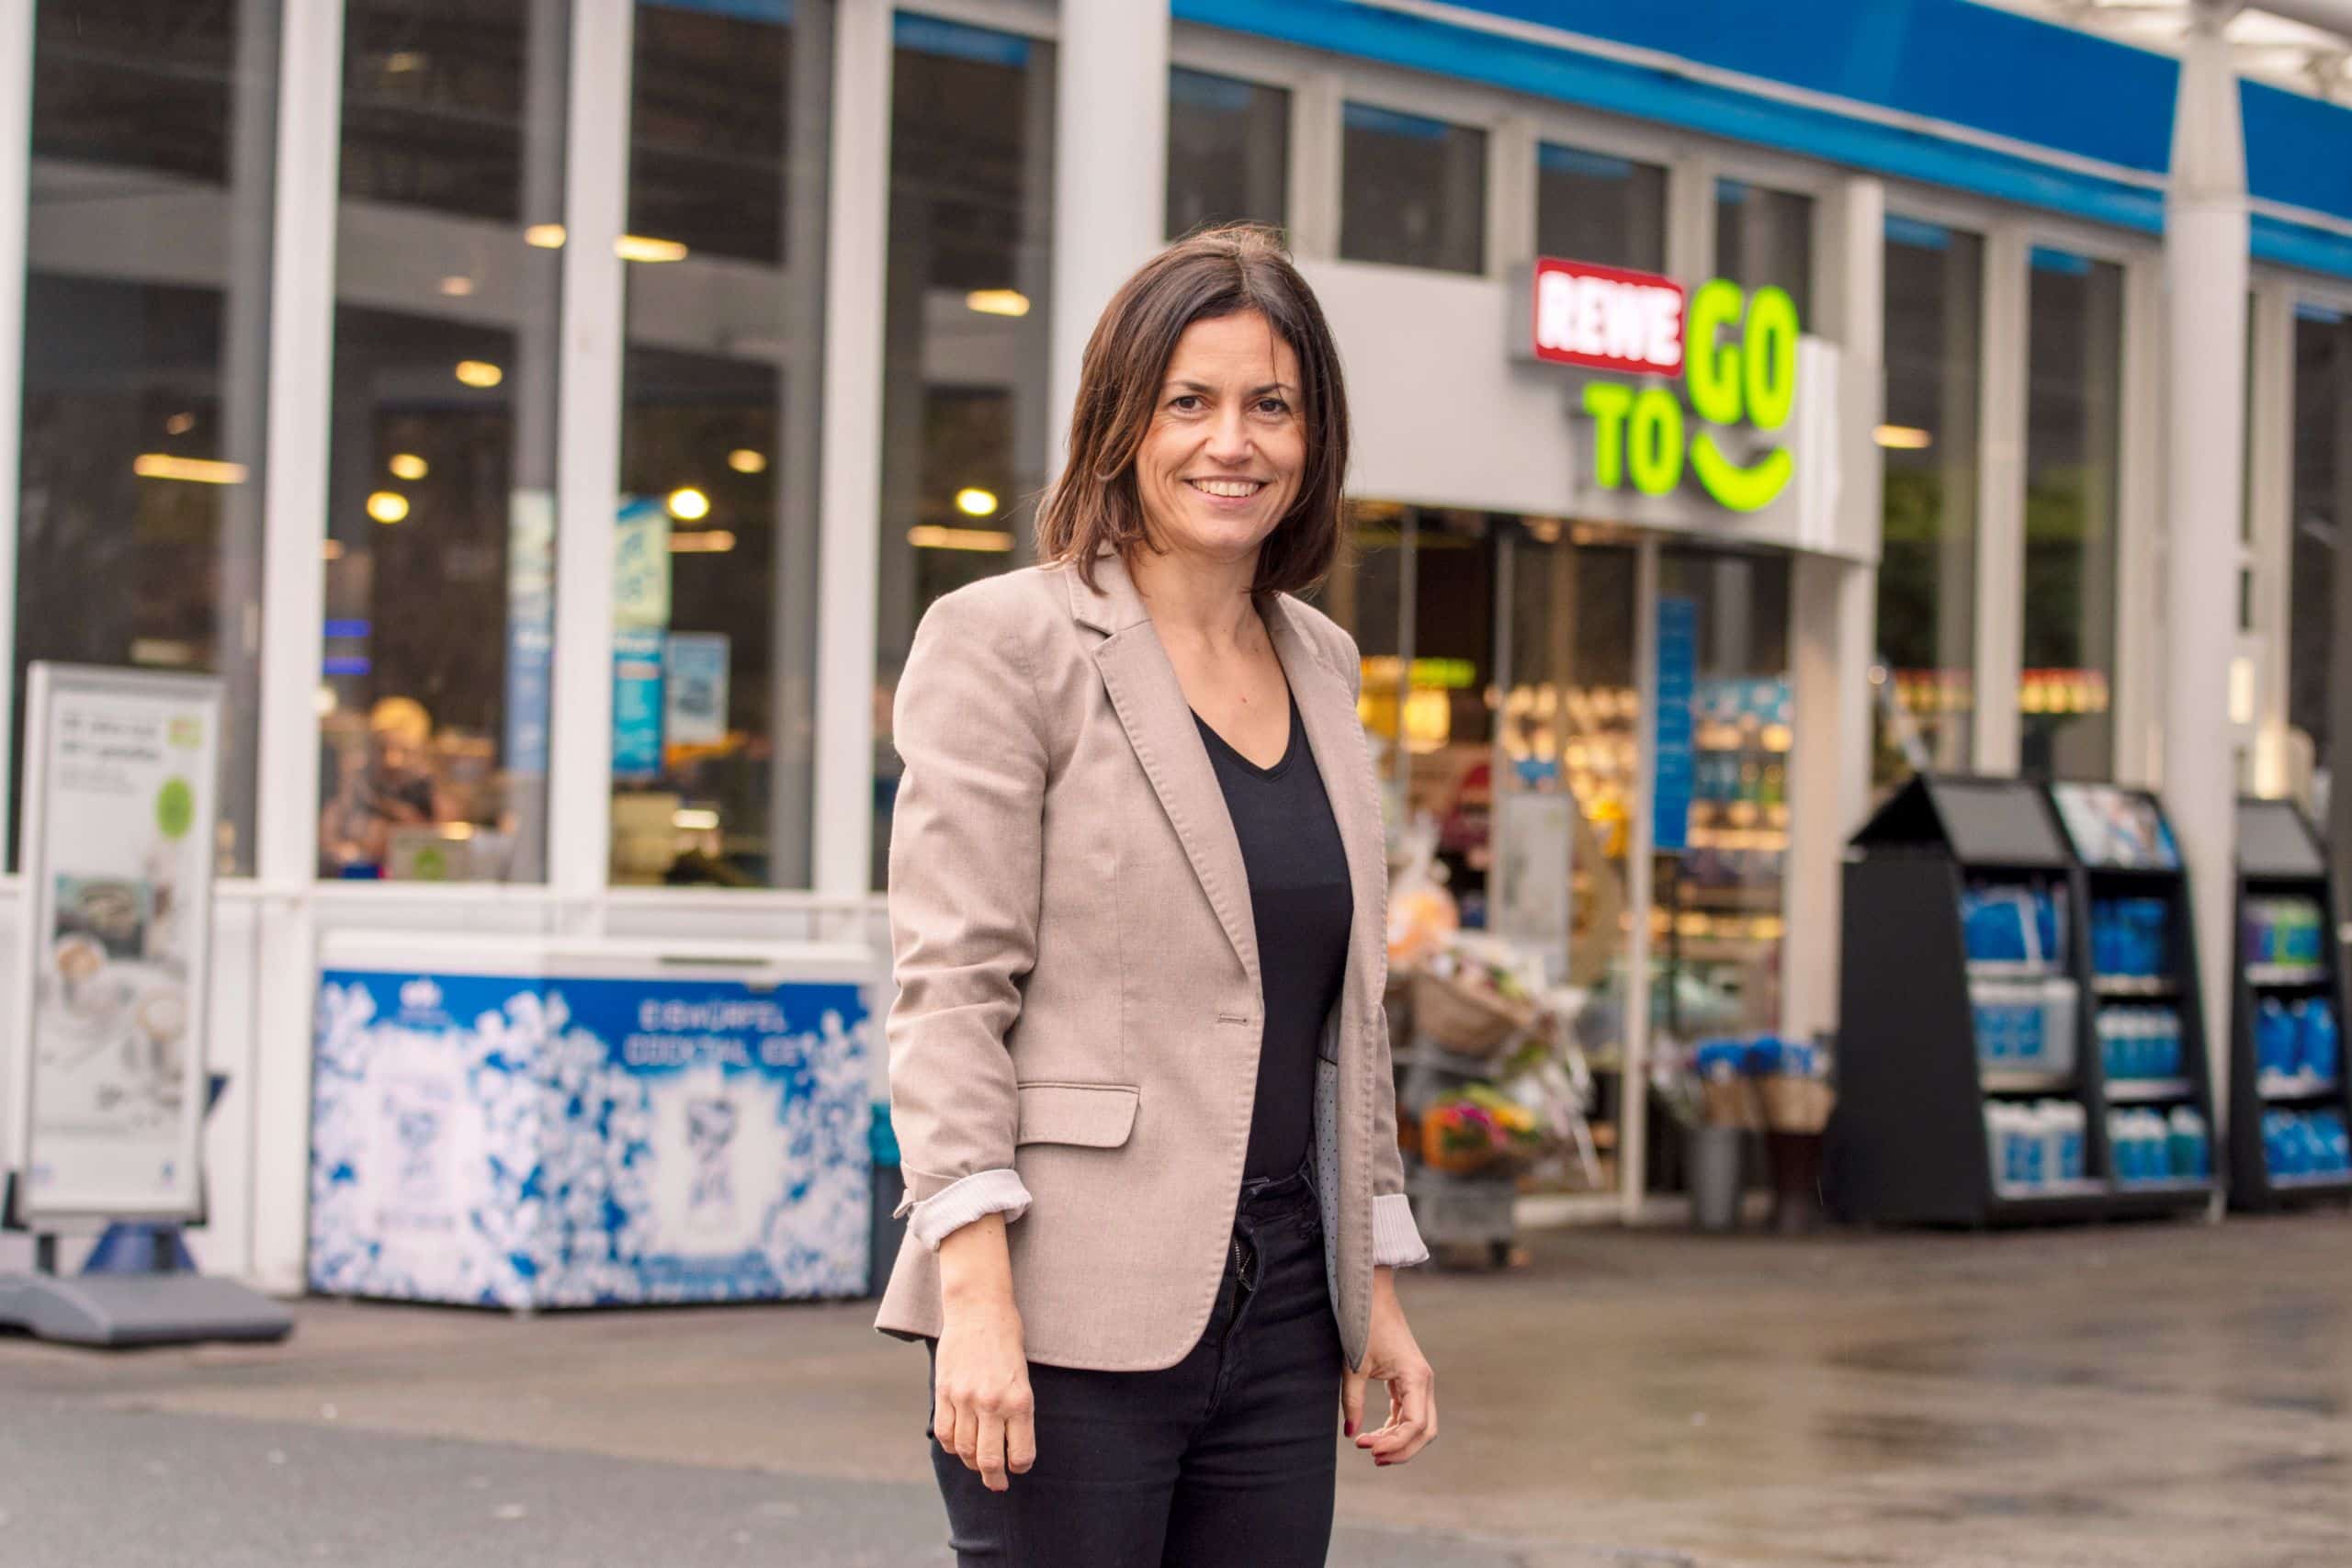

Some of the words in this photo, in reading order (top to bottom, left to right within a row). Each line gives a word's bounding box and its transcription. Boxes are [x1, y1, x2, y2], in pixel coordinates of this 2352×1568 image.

[1538, 270, 1681, 367] REWE
[1687, 278, 1799, 430] GO
[1583, 379, 1683, 496] TO
